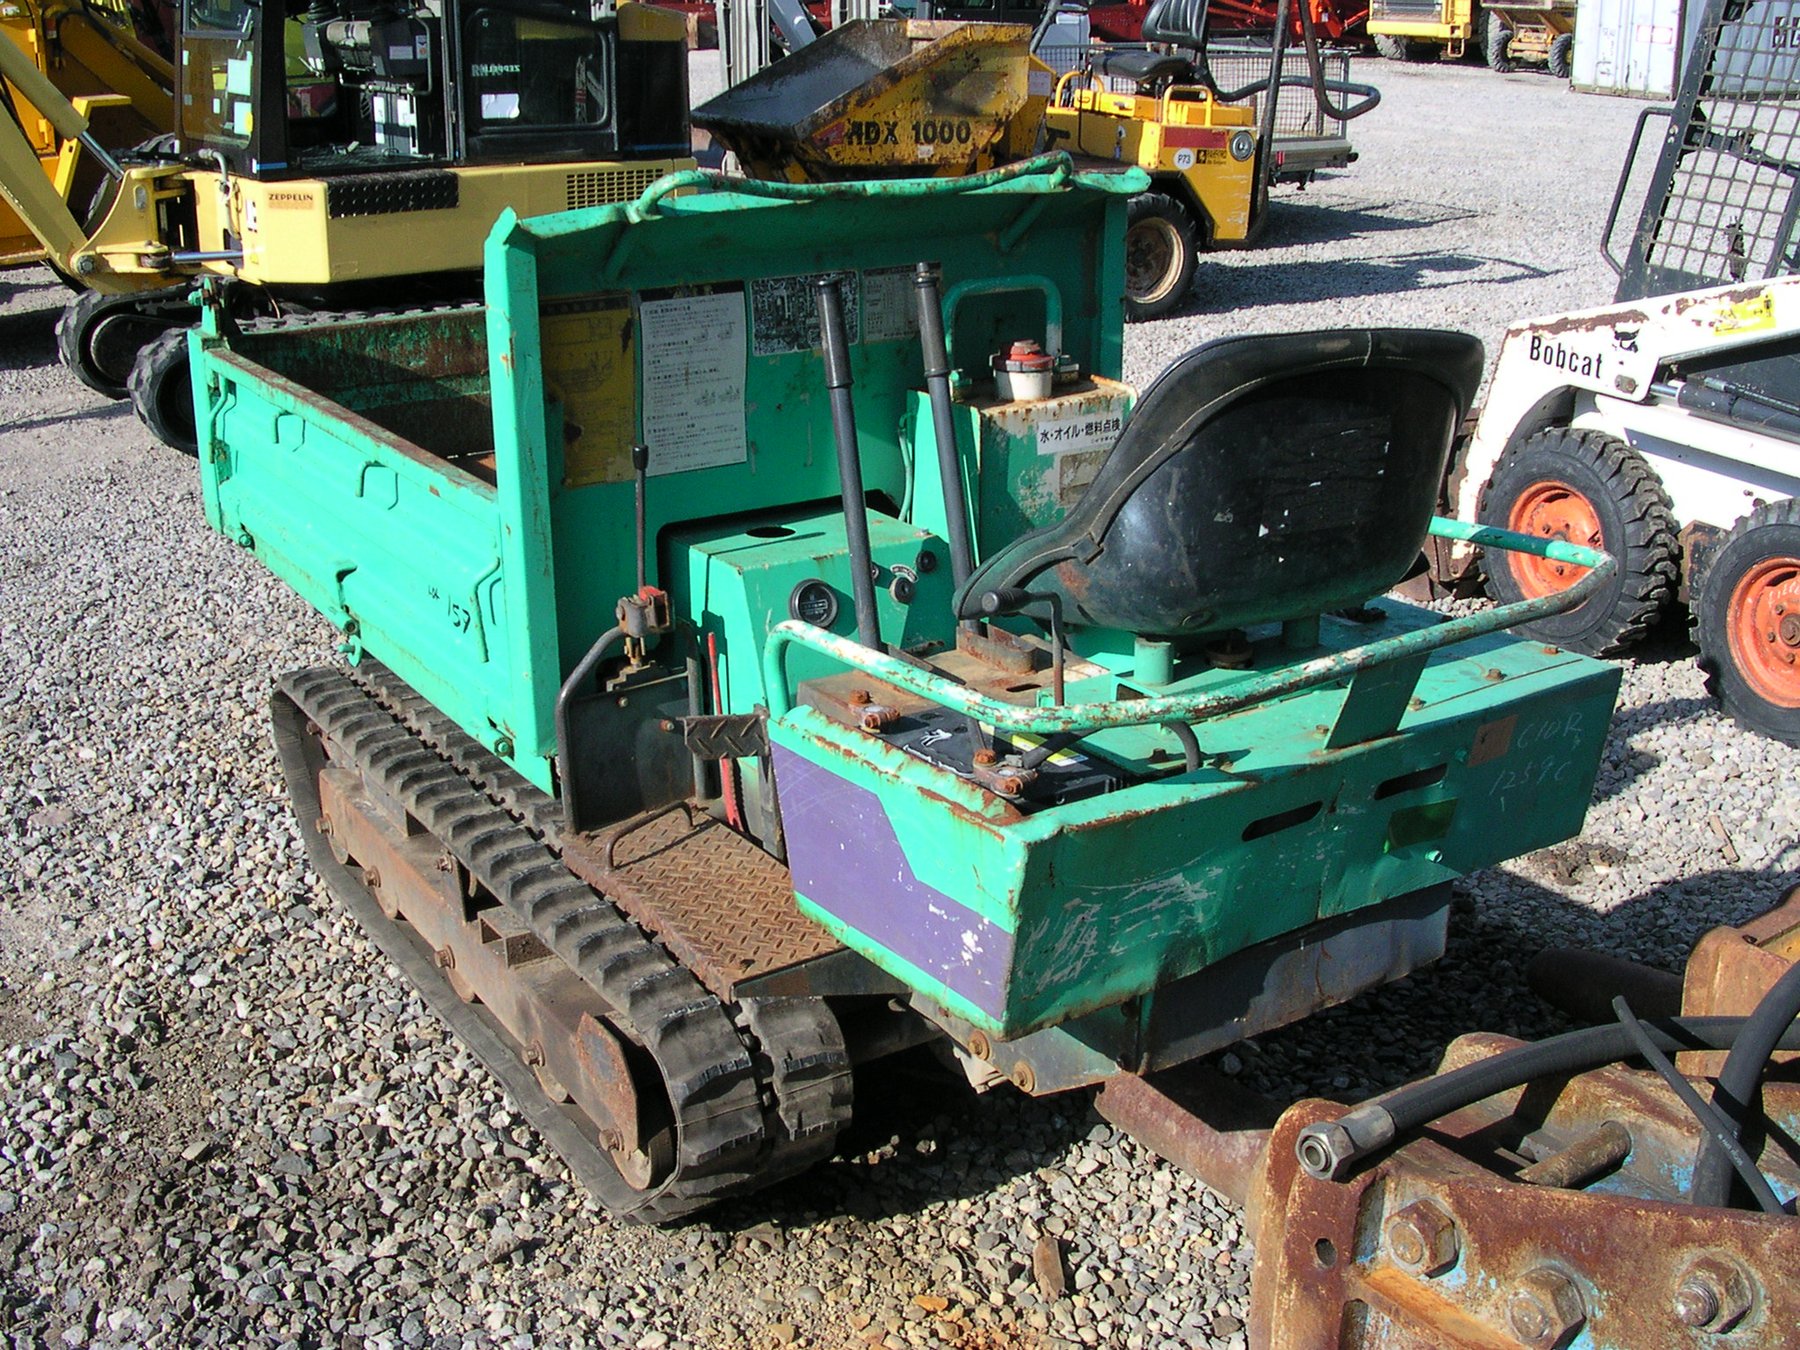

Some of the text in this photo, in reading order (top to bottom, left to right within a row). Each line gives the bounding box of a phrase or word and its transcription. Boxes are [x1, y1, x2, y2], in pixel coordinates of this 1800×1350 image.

[911, 120, 971, 145] 1000
[1177, 154, 1192, 165] P73
[268, 193, 313, 201] ZEPPELIN
[1529, 335, 1602, 379] Bobcat
